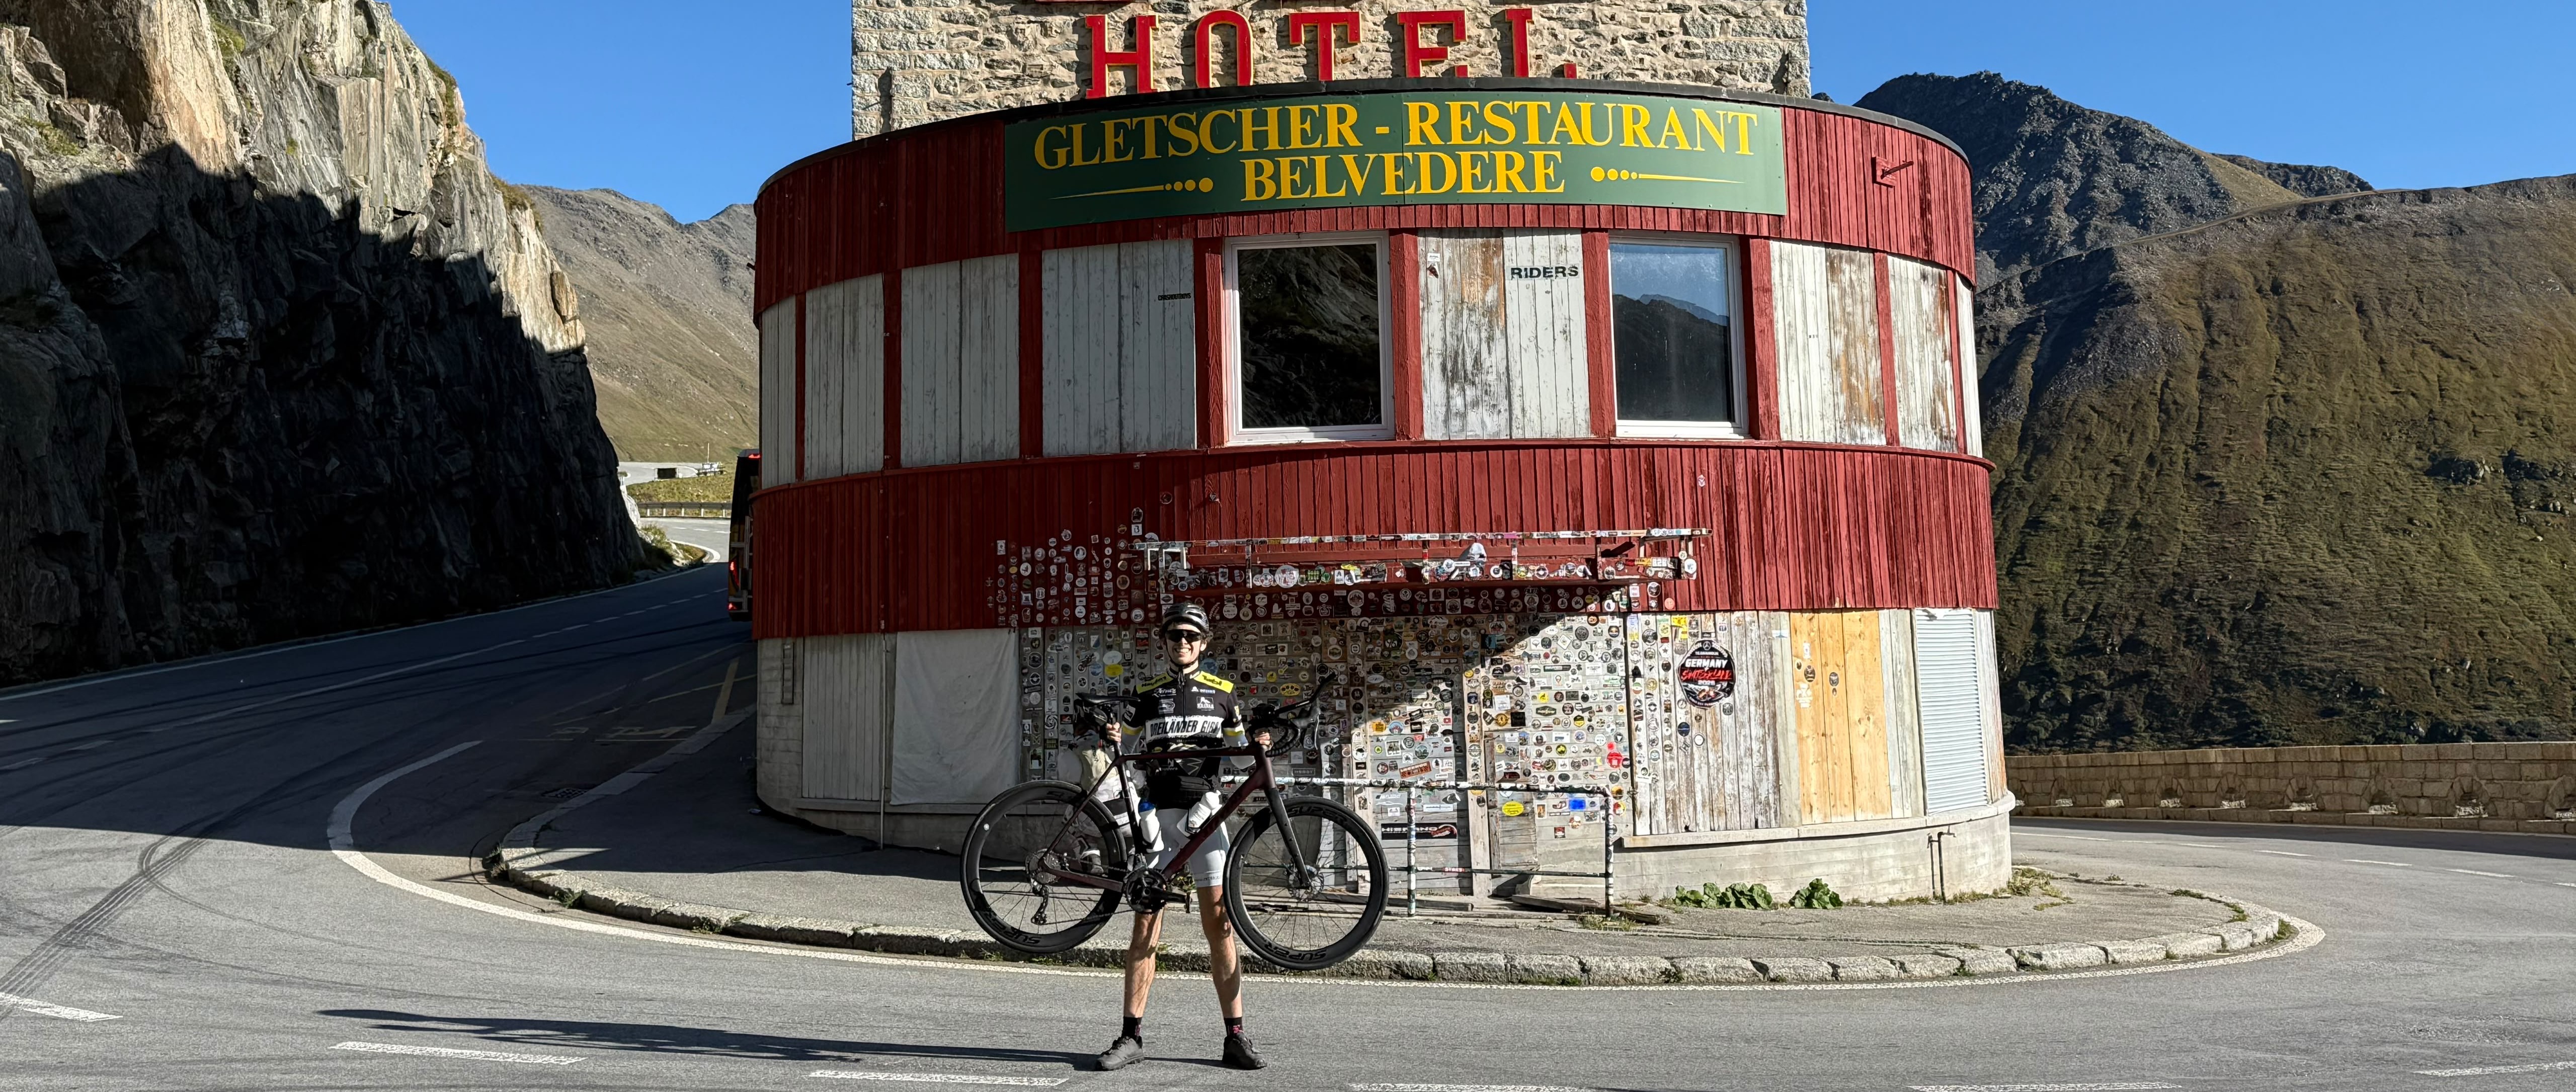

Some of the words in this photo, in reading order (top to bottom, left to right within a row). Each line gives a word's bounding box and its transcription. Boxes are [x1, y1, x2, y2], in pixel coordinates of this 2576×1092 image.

[1085, 8, 1577, 100] HOTEL
[1034, 104, 1361, 171] GLETSCHER
[1407, 102, 1759, 155] RESTAURANT
[1241, 151, 1565, 202] BELVEDERE
[1510, 266, 1579, 280] RIDERS
[1685, 658, 1728, 668] GERMANY
[1150, 719, 1198, 737] DREILÄNDER
[1264, 939, 1327, 961] SUPER
